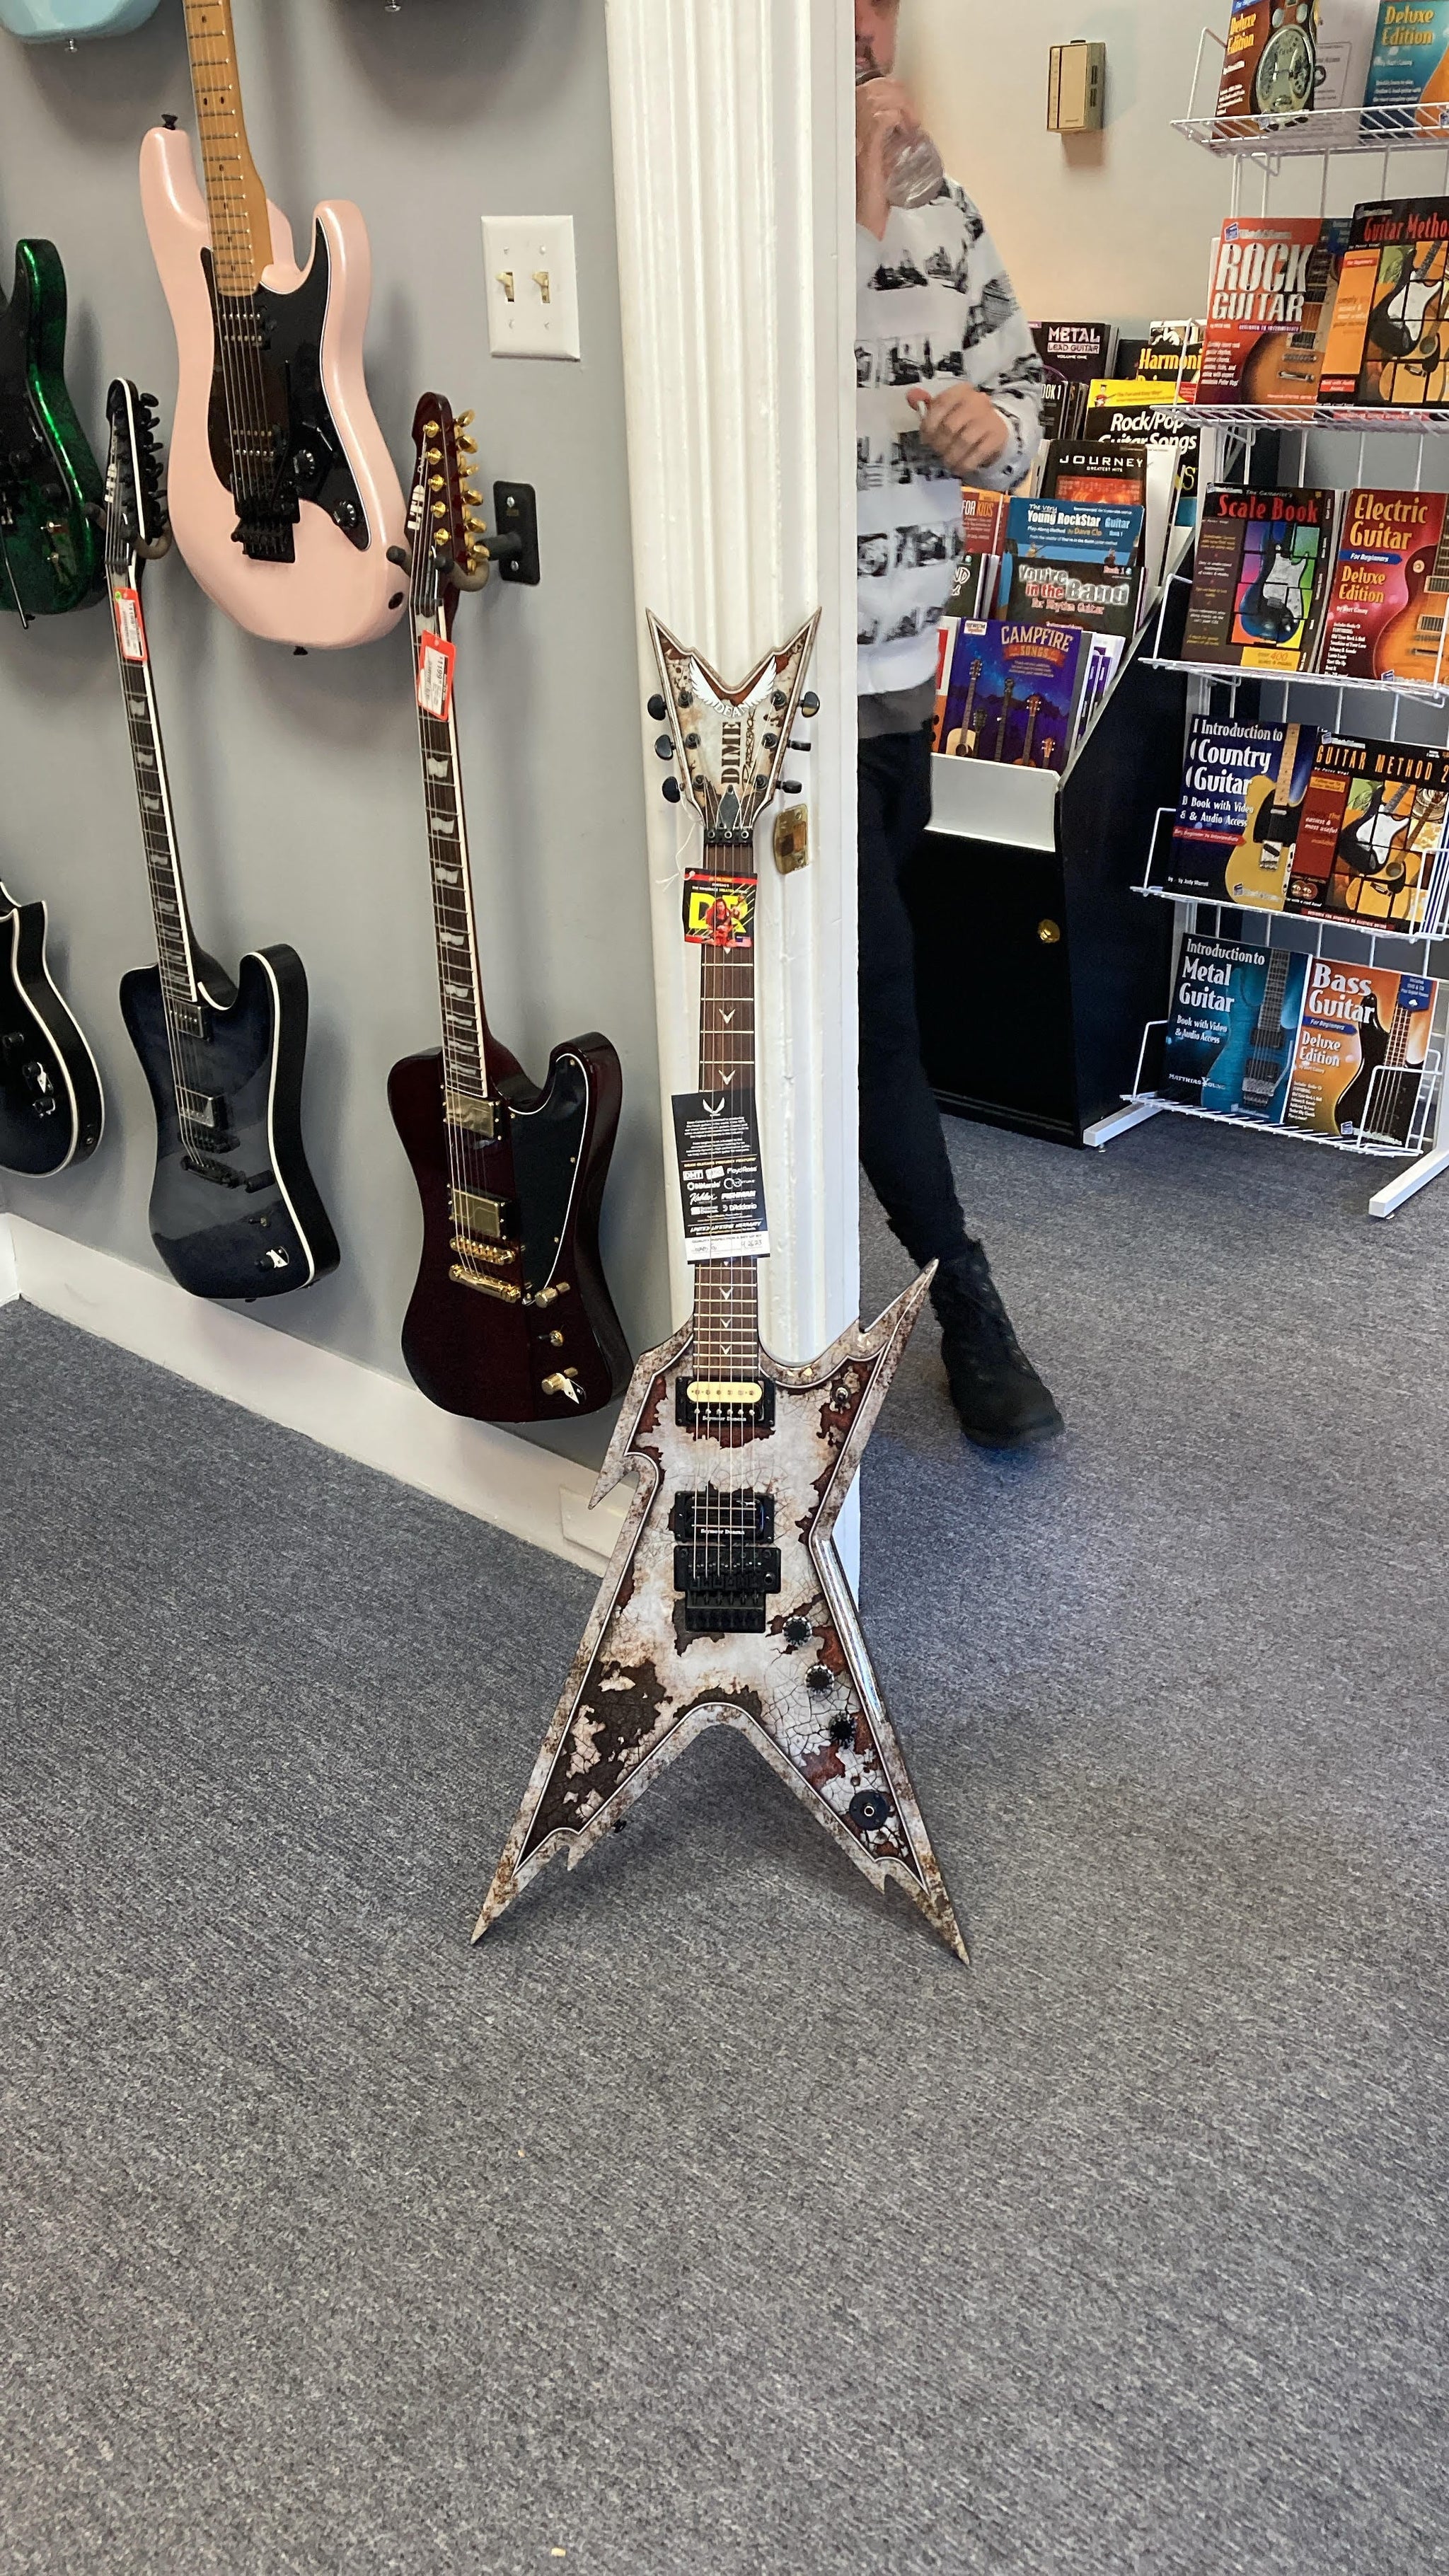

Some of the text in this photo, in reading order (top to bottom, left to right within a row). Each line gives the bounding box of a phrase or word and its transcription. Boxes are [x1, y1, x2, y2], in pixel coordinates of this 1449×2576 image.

[1230, 13, 1257, 35] Deluxe
[1385, 5, 1434, 25] Deluxe
[1228, 32, 1254, 54] Edition
[1381, 27, 1433, 46] Edition
[1363, 212, 1449, 242] Guitar Metho
[1215, 242, 1314, 293] ROCK
[1212, 291, 1305, 323] GUITAR
[1048, 326, 1101, 343] METAL
[1048, 343, 1099, 353] LEAD GUITAR
[1138, 347, 1203, 370] Harmoni
[1041, 383, 1061, 400] OOK 1
[1110, 410, 1185, 434] Rock/Pop
[1150, 432, 1197, 456] Songs
[1059, 455, 1143, 468] JOURNEY
[962, 499, 994, 517] FOR KIDS
[1027, 509, 1131, 529] Young RockStar Guitar
[1217, 493, 1319, 524] Scale Book
[1354, 494, 1428, 524] Electric
[1349, 520, 1413, 550] Guitar
[1361, 554, 1390, 563] Beginners
[954, 567, 971, 584] ND
[1019, 564, 1069, 586] You're
[1341, 565, 1386, 586] Deluxe
[1026, 578, 1130, 606] in the Band
[1339, 583, 1385, 603] Edition
[1001, 625, 1074, 652] CAMPFIRE
[1020, 645, 1050, 658] SONGS
[1271, 652, 1288, 662] 400
[714, 700, 751, 718] DEAN
[1201, 719, 1283, 741] Introduction to
[721, 722, 741, 785] DIME
[1198, 739, 1272, 774] Country
[1316, 744, 1449, 783] GUITAR METHOD 2
[1194, 766, 1253, 796] Guitar
[1191, 797, 1254, 814] Book with Video
[1189, 812, 1248, 827] & Audio Access
[1187, 938, 1265, 966] Introduction to
[1182, 956, 1232, 986] Metal
[1312, 963, 1372, 997] Bass
[1179, 982, 1235, 1012] Guitar
[1309, 989, 1375, 1024] Guitar
[1177, 1015, 1228, 1032] Book with Video
[1319, 1020, 1346, 1032] Beginners
[1182, 1029, 1200, 1040] Audio
[1200, 1032, 1220, 1044] Access
[1302, 1030, 1341, 1051] Deluxe
[1299, 1046, 1340, 1068] Edition
[1169, 1073, 1201, 1085] MATTHIAS
